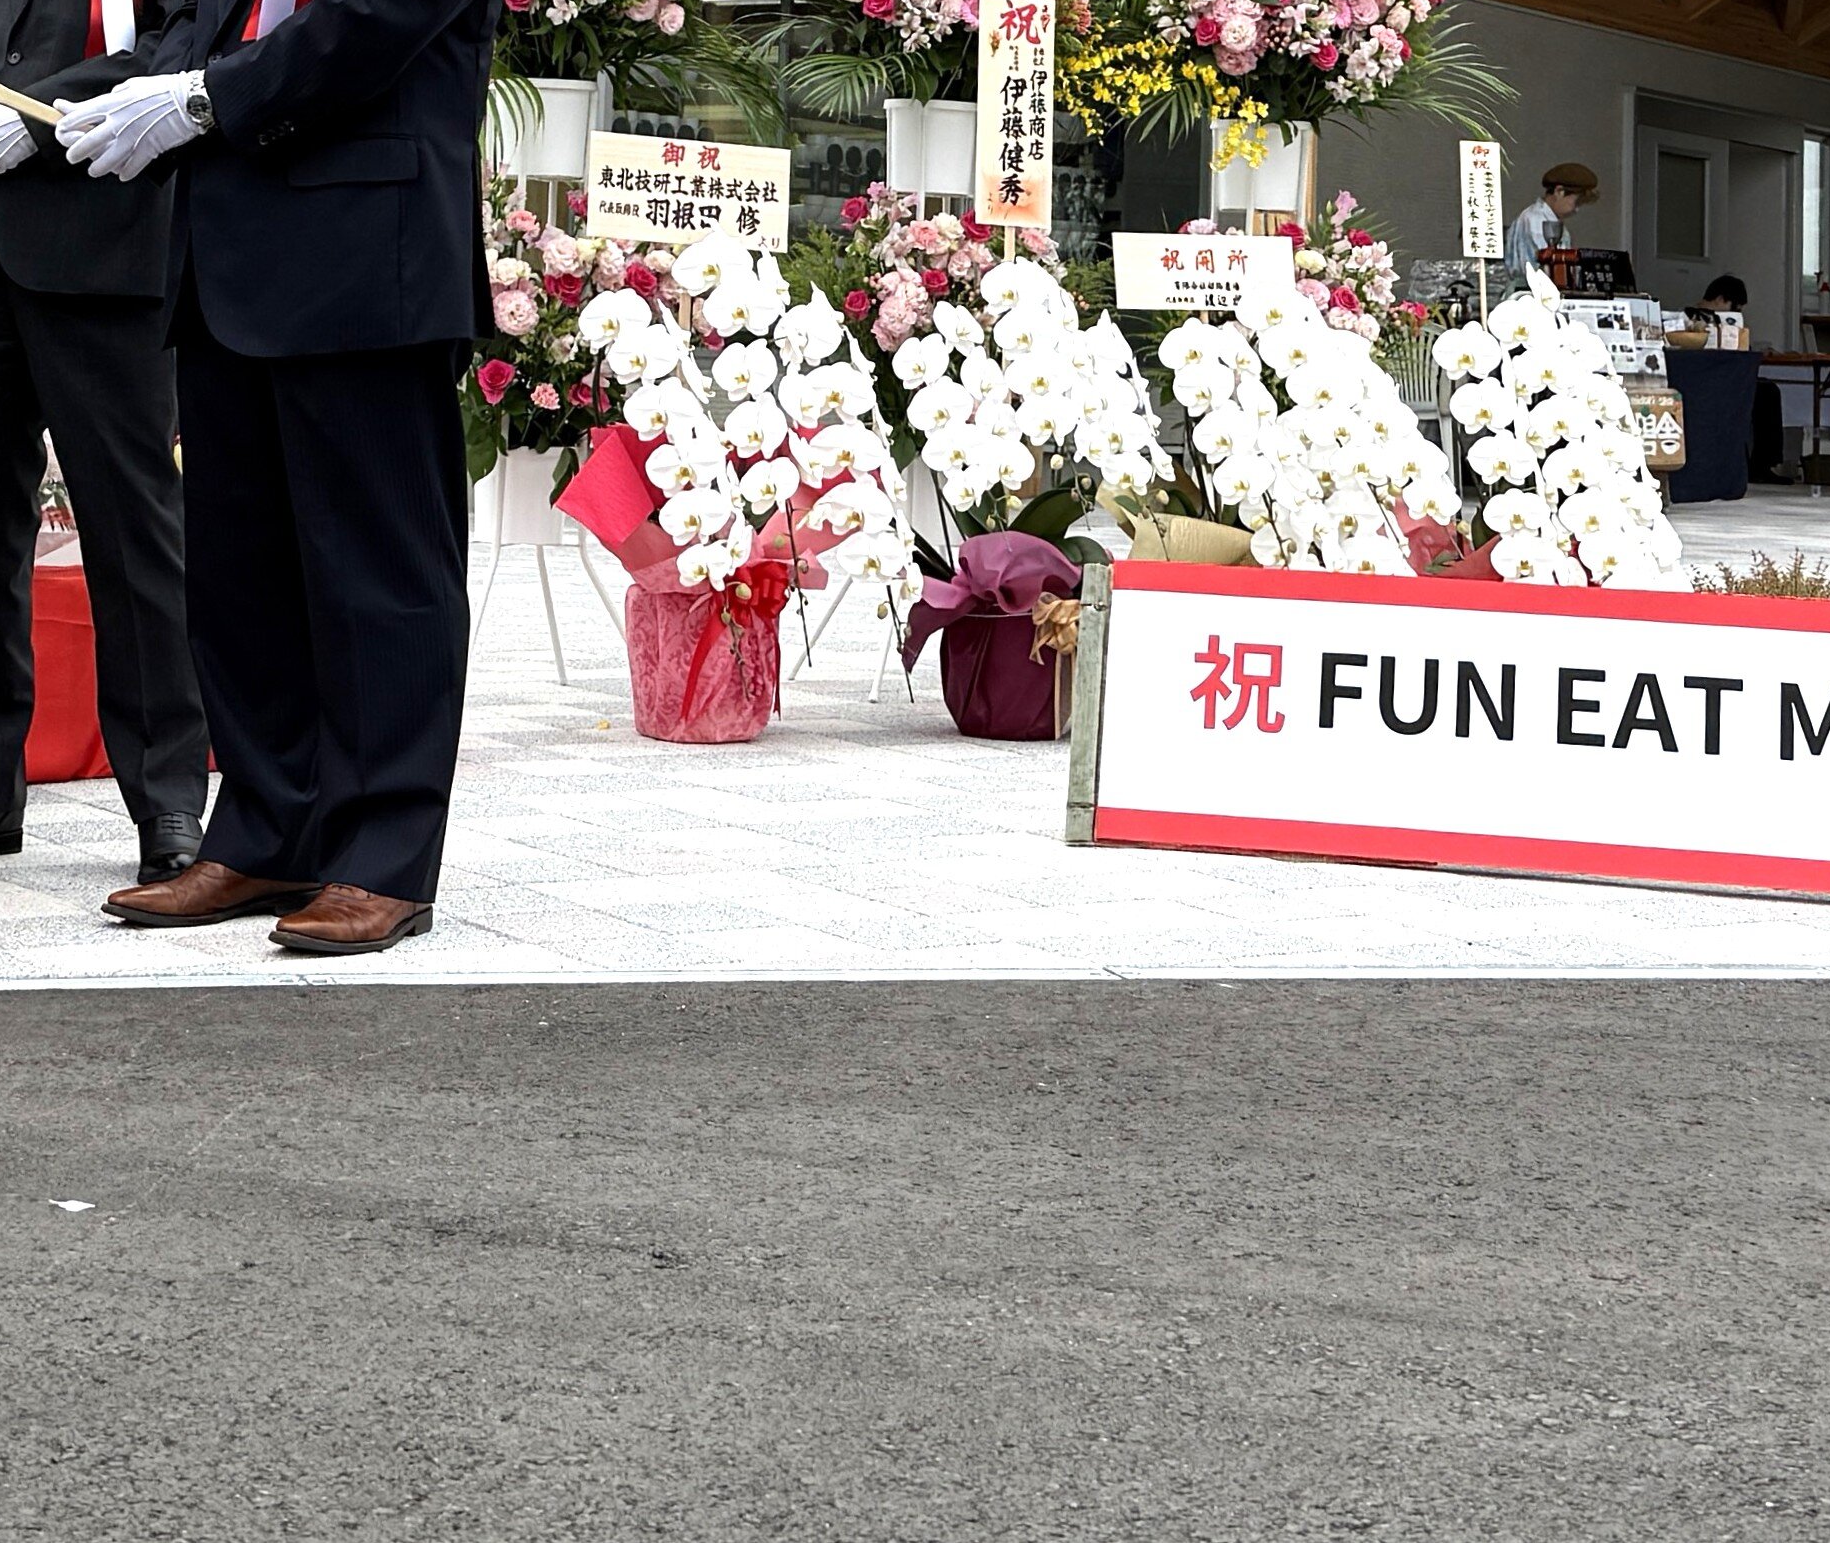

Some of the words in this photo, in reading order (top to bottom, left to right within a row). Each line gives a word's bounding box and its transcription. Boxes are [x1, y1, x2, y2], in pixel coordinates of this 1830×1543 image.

[661, 141, 722, 171] 御祝
[999, 75, 1027, 206] 伊藤健秀
[597, 164, 780, 204] 東北技研工業株式会社
[757, 236, 781, 249] より
[1191, 634, 1286, 734] 祝
[1318, 651, 1518, 743] FUN
[1556, 666, 1744, 757] EAT
